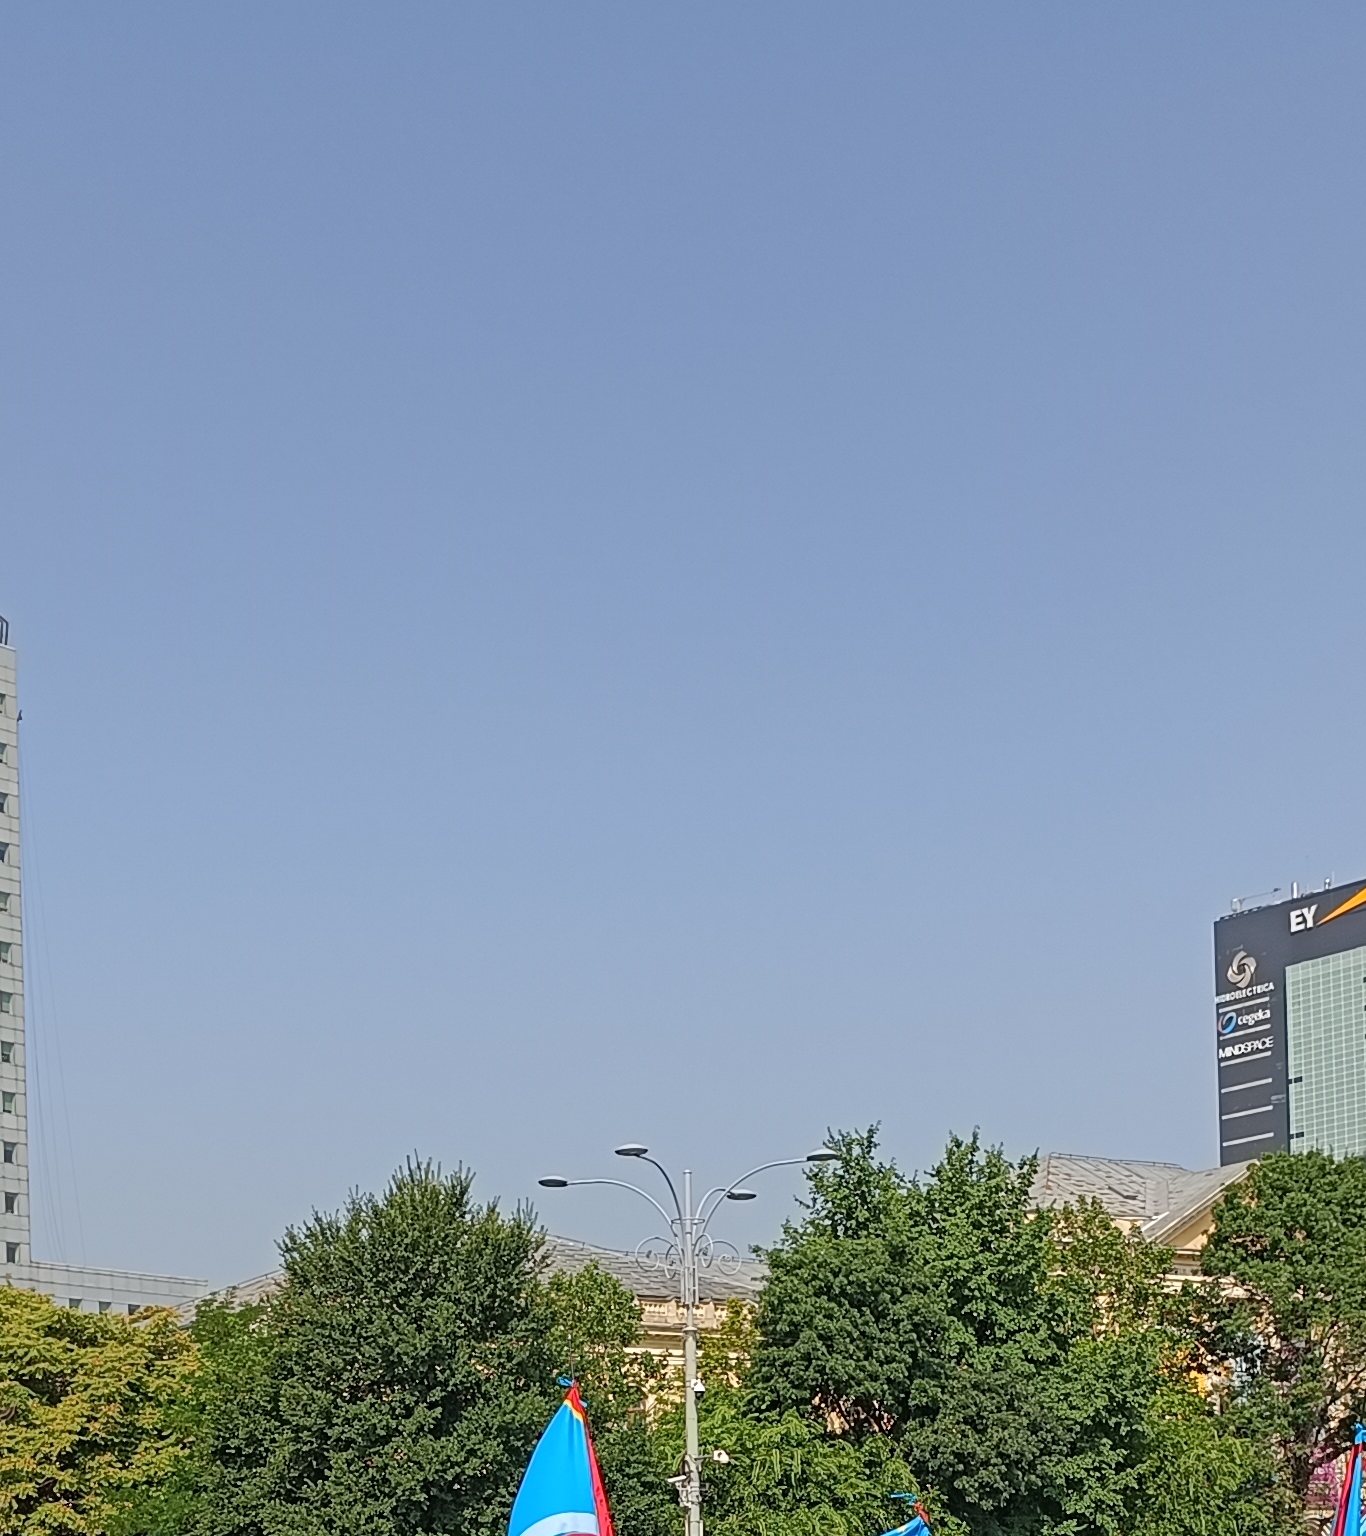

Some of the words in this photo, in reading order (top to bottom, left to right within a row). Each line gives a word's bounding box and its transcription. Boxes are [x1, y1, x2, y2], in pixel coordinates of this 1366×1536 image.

[1290, 905, 1318, 933] EY
[1238, 1009, 1270, 1026] cegeka
[1219, 1036, 1274, 1059] MINDSPACE
